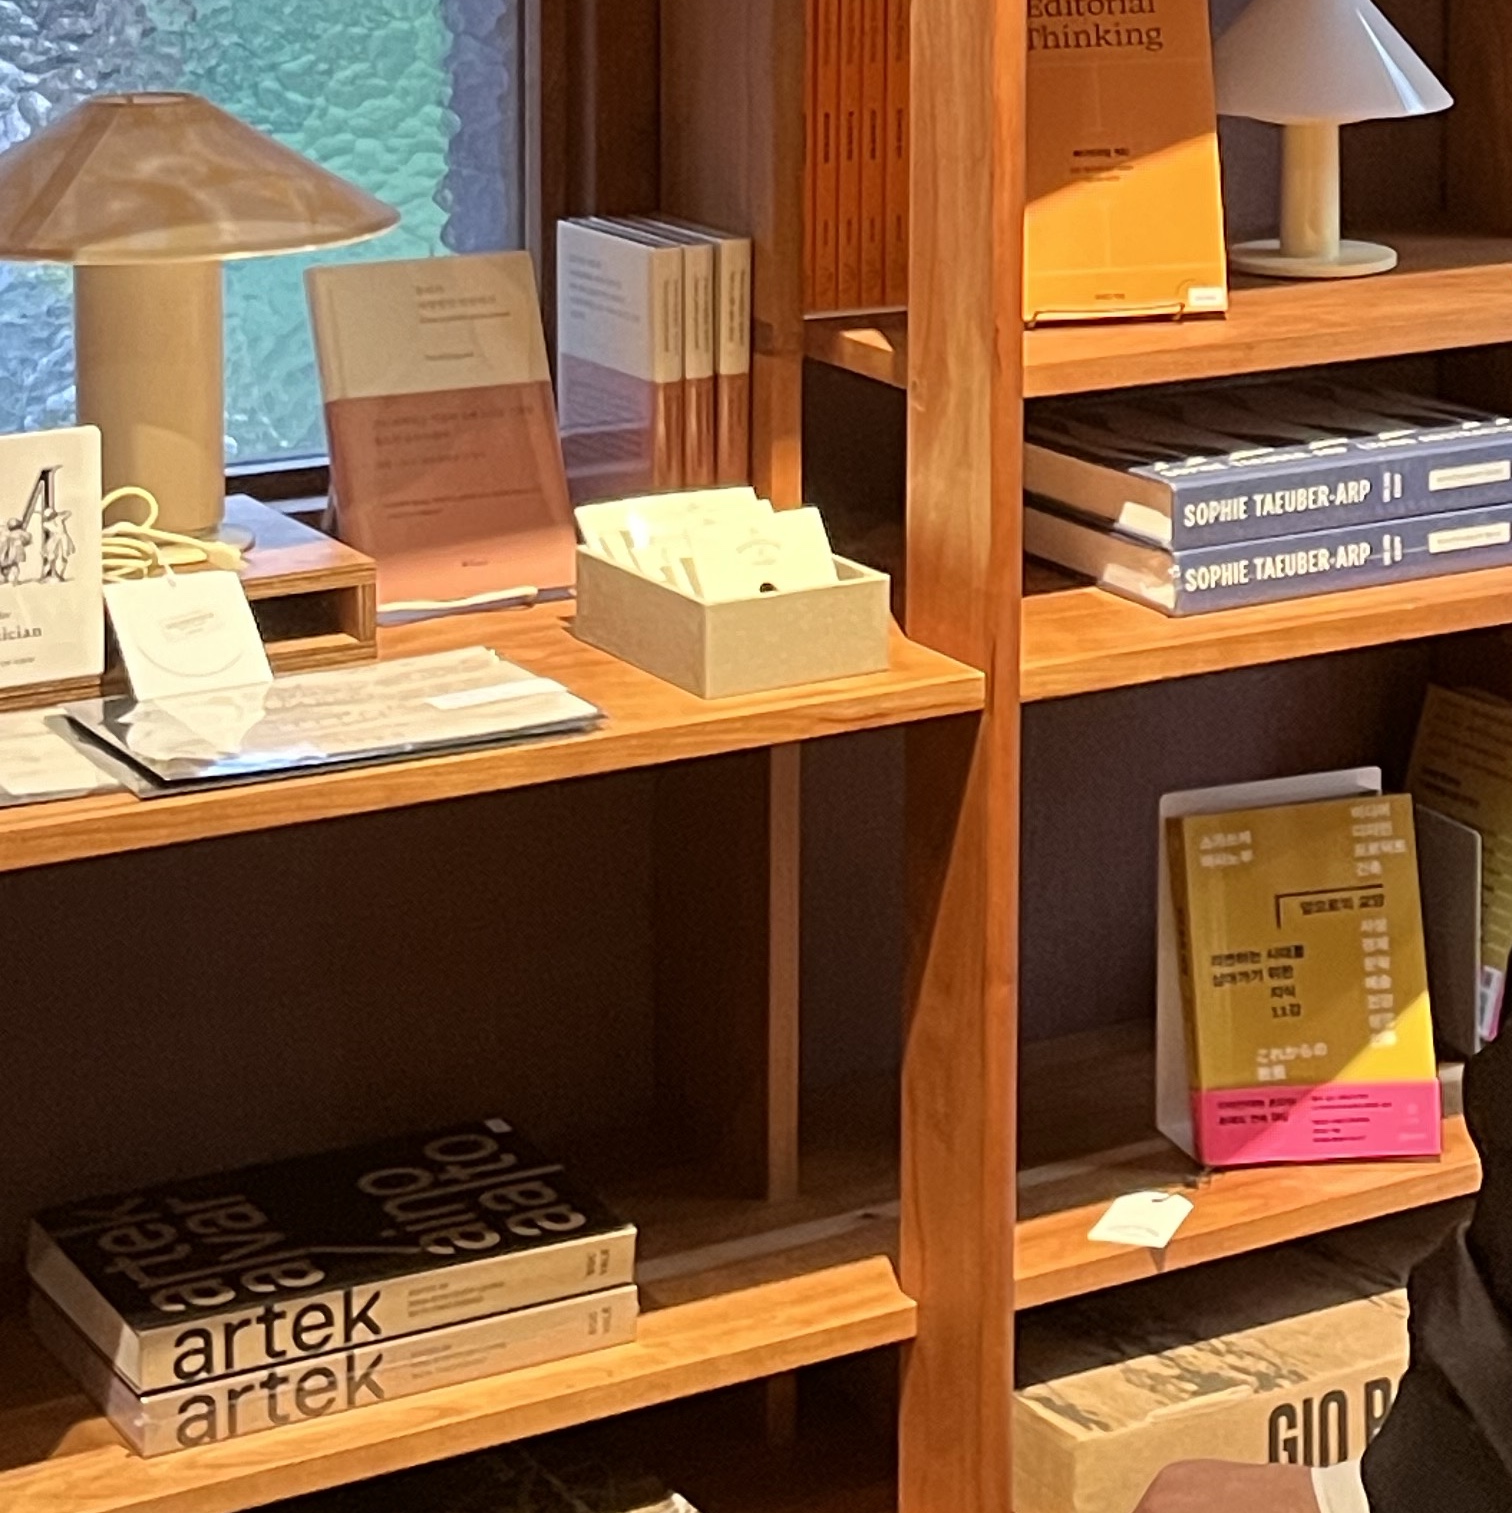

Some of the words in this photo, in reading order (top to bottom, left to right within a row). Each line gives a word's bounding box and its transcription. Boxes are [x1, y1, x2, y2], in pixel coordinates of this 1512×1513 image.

[1028, 22, 1164, 52] Thinking
[1183, 496, 1250, 528] SOPHIE
[1253, 479, 1372, 518] TAEUBER-ARP
[1184, 559, 1250, 592] SOPHIE
[1253, 541, 1372, 581] TAEUBER-ARP
[173, 1289, 383, 1381] artek
[176, 1352, 386, 1448] artek
